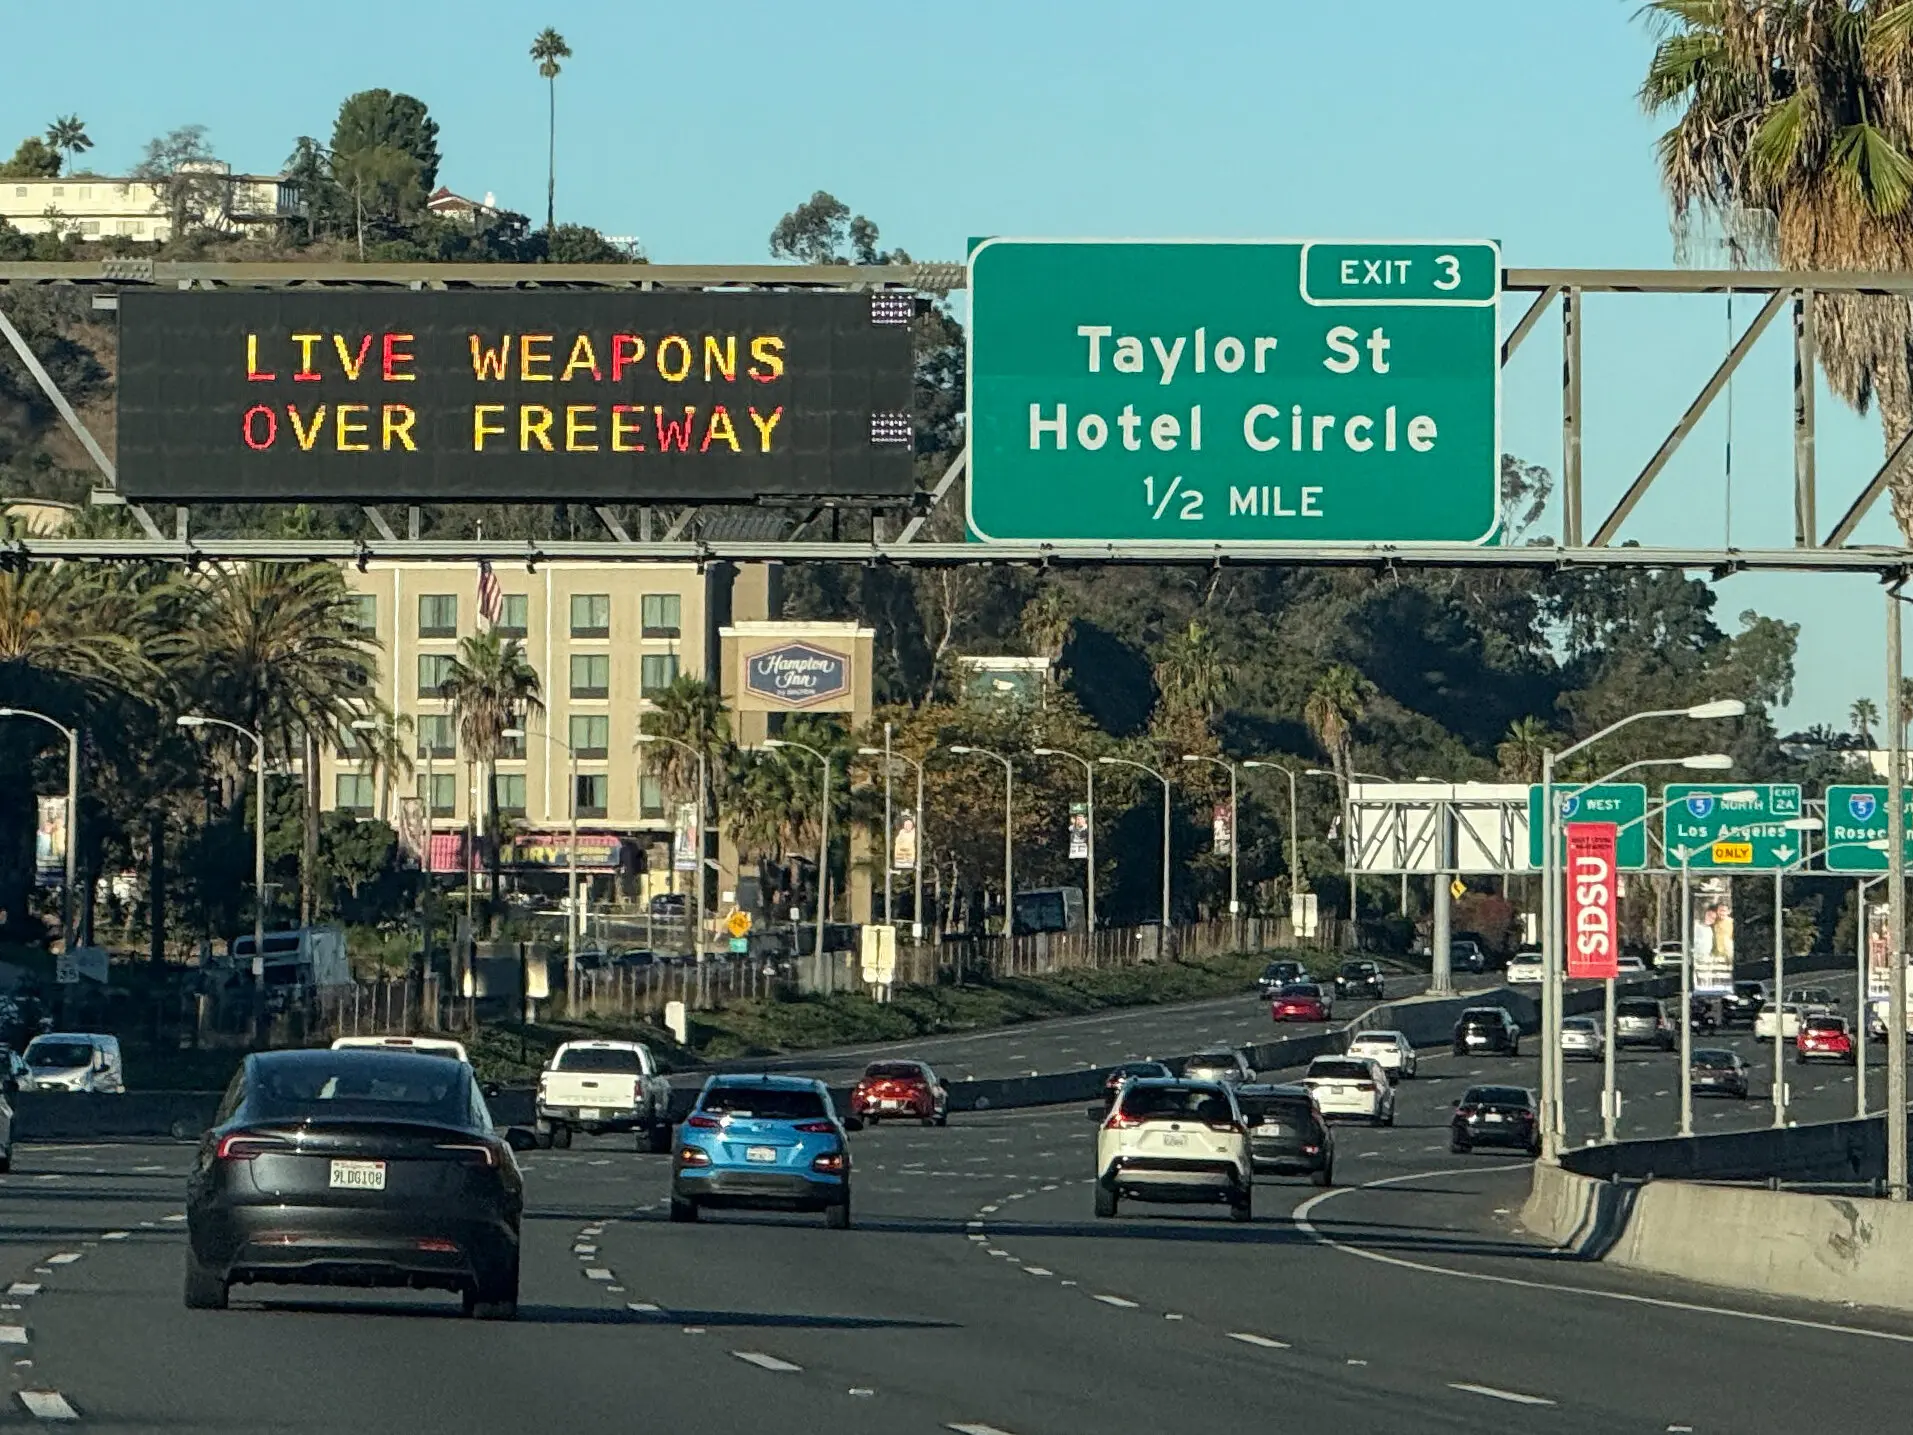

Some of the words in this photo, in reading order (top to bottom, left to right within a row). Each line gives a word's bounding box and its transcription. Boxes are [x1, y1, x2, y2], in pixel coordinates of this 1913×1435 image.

[1341, 261, 1411, 284] EXIT
[1434, 255, 1461, 291] 3
[247, 333, 416, 382] LIVE
[470, 334, 786, 383] WEAPONS
[1077, 325, 1277, 384] Taylor
[1323, 326, 1391, 374] St
[243, 404, 418, 452] OVER
[474, 404, 784, 453] FREEWAY
[1029, 403, 1200, 451] Hotel
[1244, 403, 1438, 452] Circle
[1143, 476, 1203, 520] 1/2
[1229, 486, 1323, 517] MILE
[757, 654, 835, 675] Hampton
[775, 671, 818, 688] Inn
[1587, 799, 1622, 810] WEST
[1696, 799, 1705, 812] 5
[1776, 800, 1795, 810] 2A
[1857, 800, 1867, 814] 5
[1678, 824, 1708, 837] Los
[1718, 824, 1787, 841] Angeles
[1715, 848, 1749, 859] ONLY
[1576, 856, 1609, 956] SDSU
